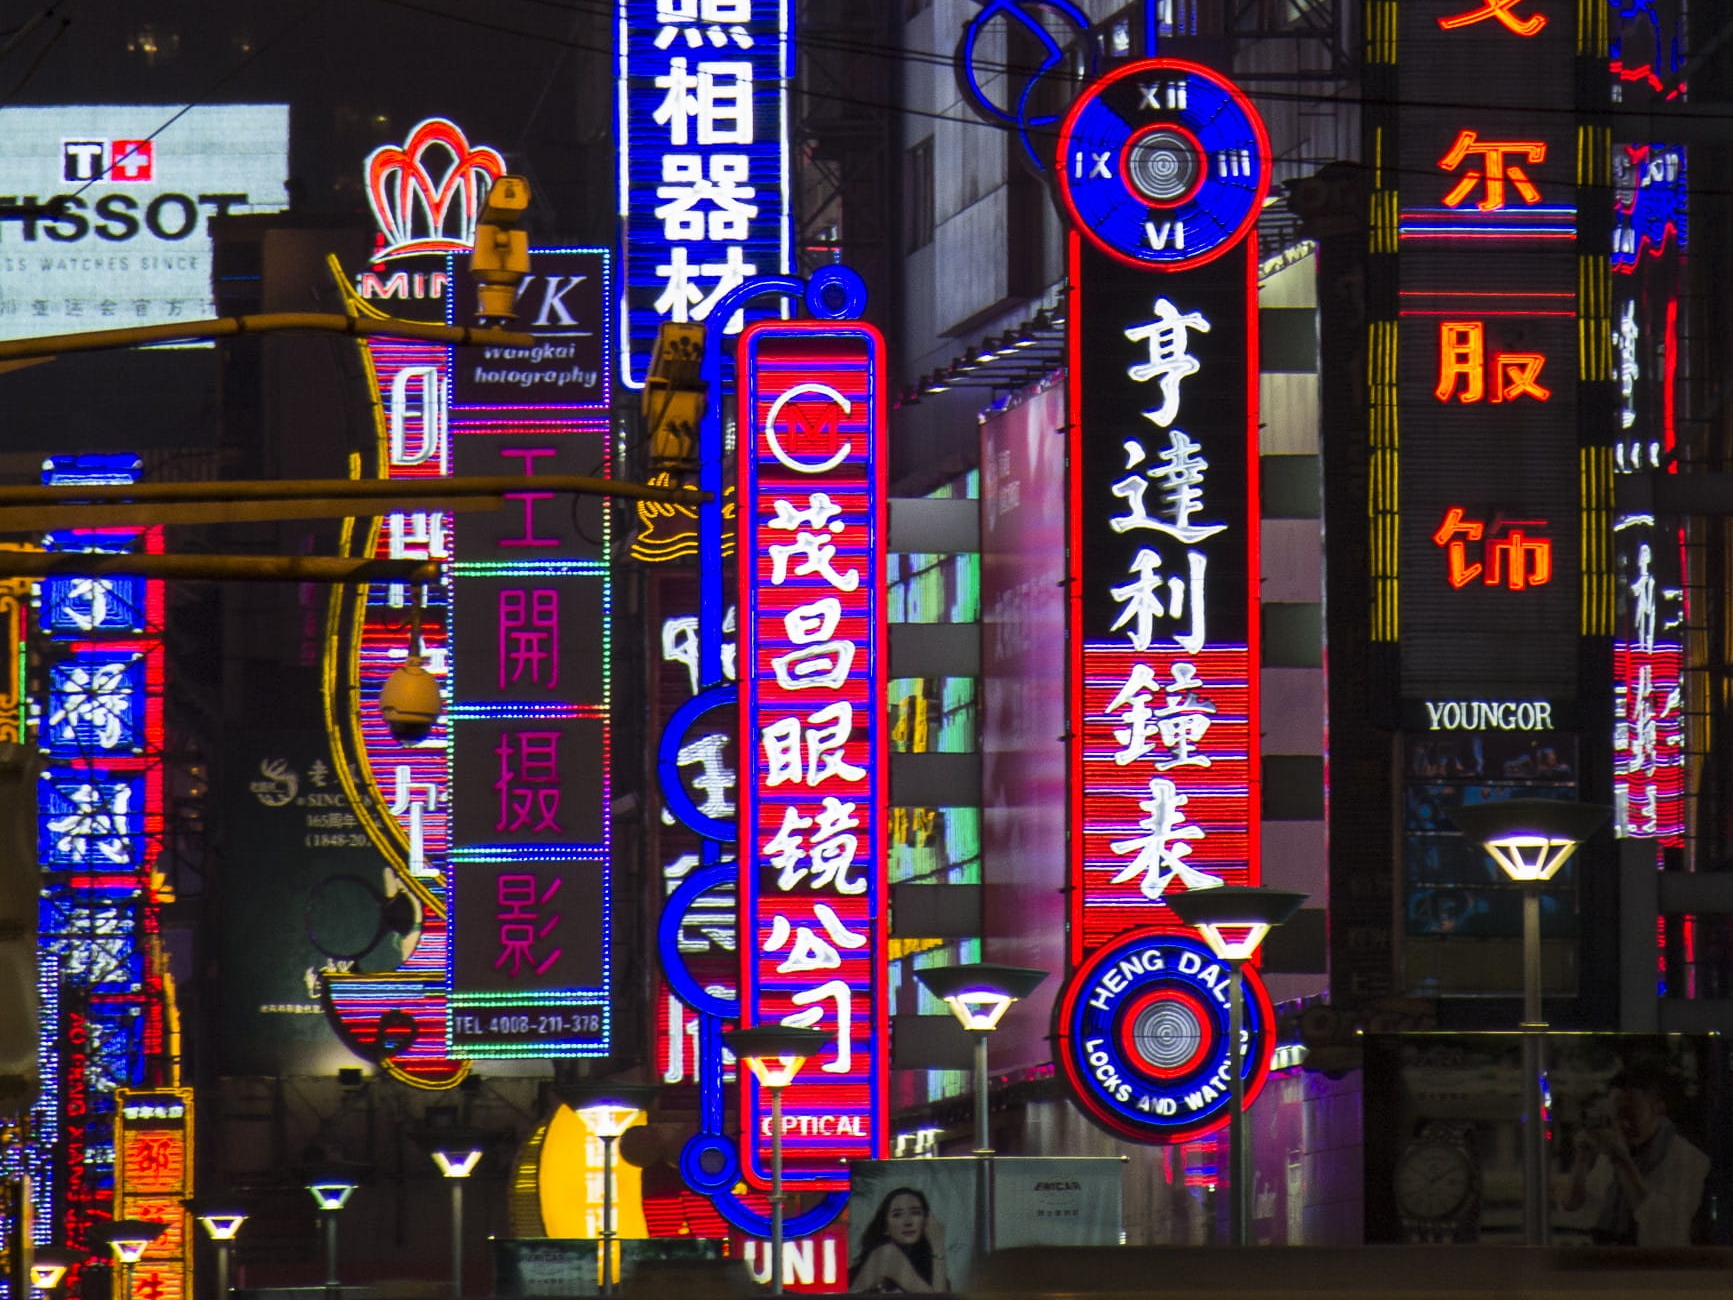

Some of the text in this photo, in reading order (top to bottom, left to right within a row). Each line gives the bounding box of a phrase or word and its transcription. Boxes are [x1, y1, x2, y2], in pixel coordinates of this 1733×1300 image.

[1145, 221, 1185, 251] VI
[41, 257, 129, 272] WATCHES
[141, 256, 200, 271] SINCE
[1425, 701, 1555, 732] YOUNGOR
[1089, 949, 1165, 1011] HENG
[455, 1016, 483, 1034] TEL
[1136, 1094, 1177, 1116] AND
